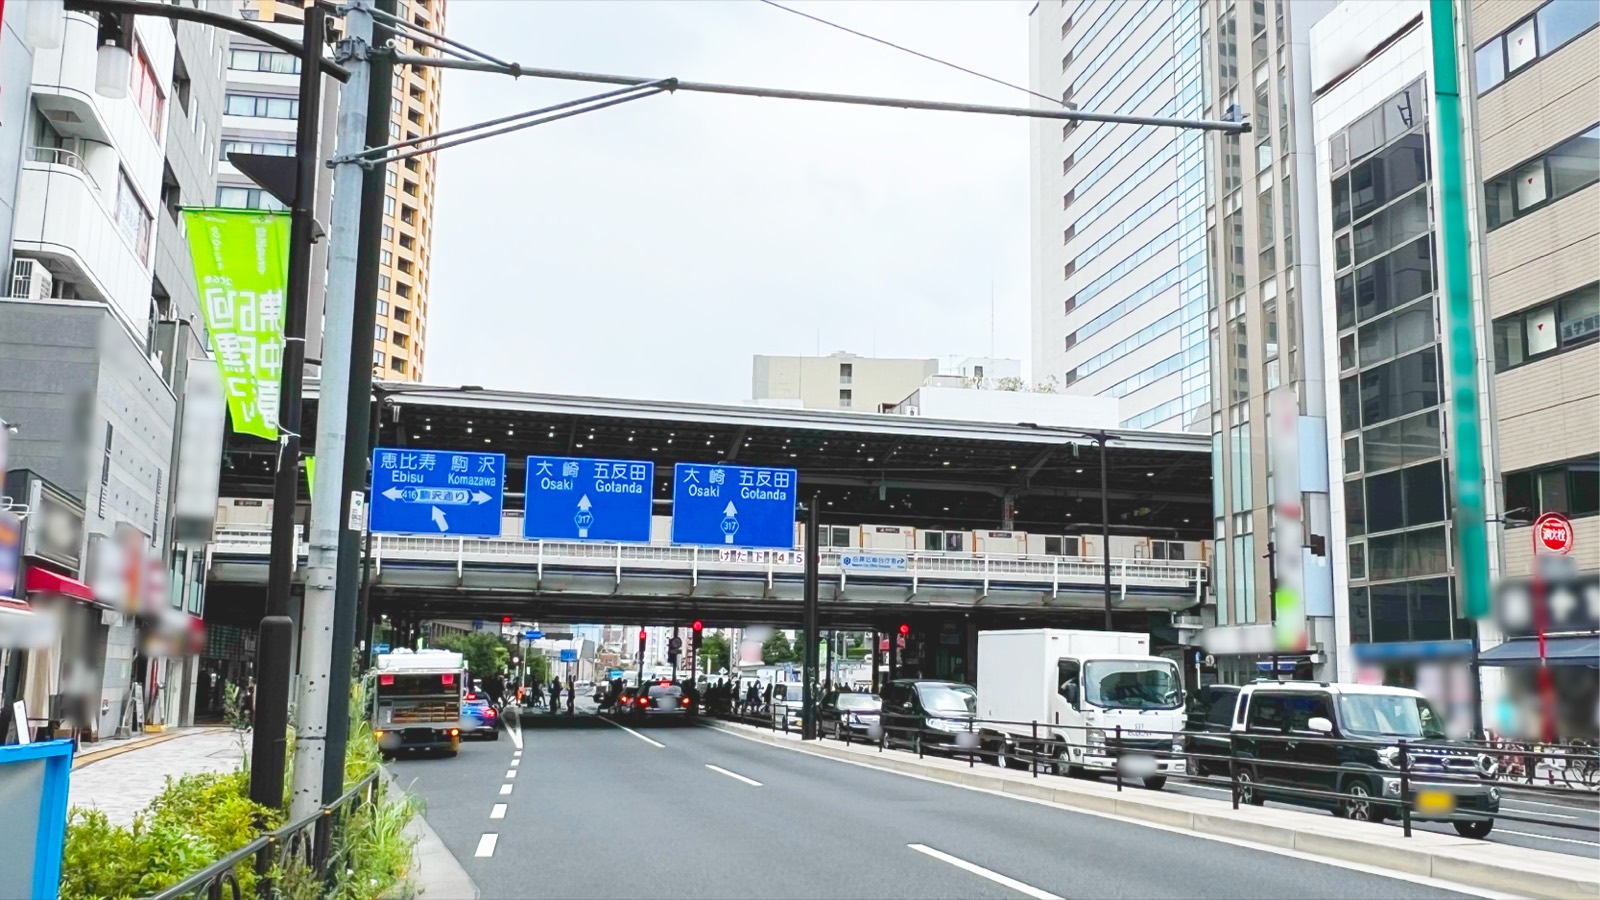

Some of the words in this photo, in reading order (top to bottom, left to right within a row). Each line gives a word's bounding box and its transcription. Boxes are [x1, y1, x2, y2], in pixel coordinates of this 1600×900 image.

[381, 452, 437, 471] 恵比寿
[451, 455, 495, 474] 駒沢
[536, 460, 580, 478] 大崎
[593, 462, 646, 481] 五反田
[392, 470, 424, 483] Ebisu
[448, 473, 496, 487] Komazawa
[541, 477, 574, 491] Osaki
[595, 480, 643, 494] Gotanda
[683, 467, 726, 486] 大崎
[739, 470, 790, 488] 五反田
[402, 490, 417, 500] 416
[688, 484, 720, 498] Osaki
[741, 487, 787, 501] Gotanda
[577, 514, 591, 524] 317
[723, 521, 737, 531] 317
